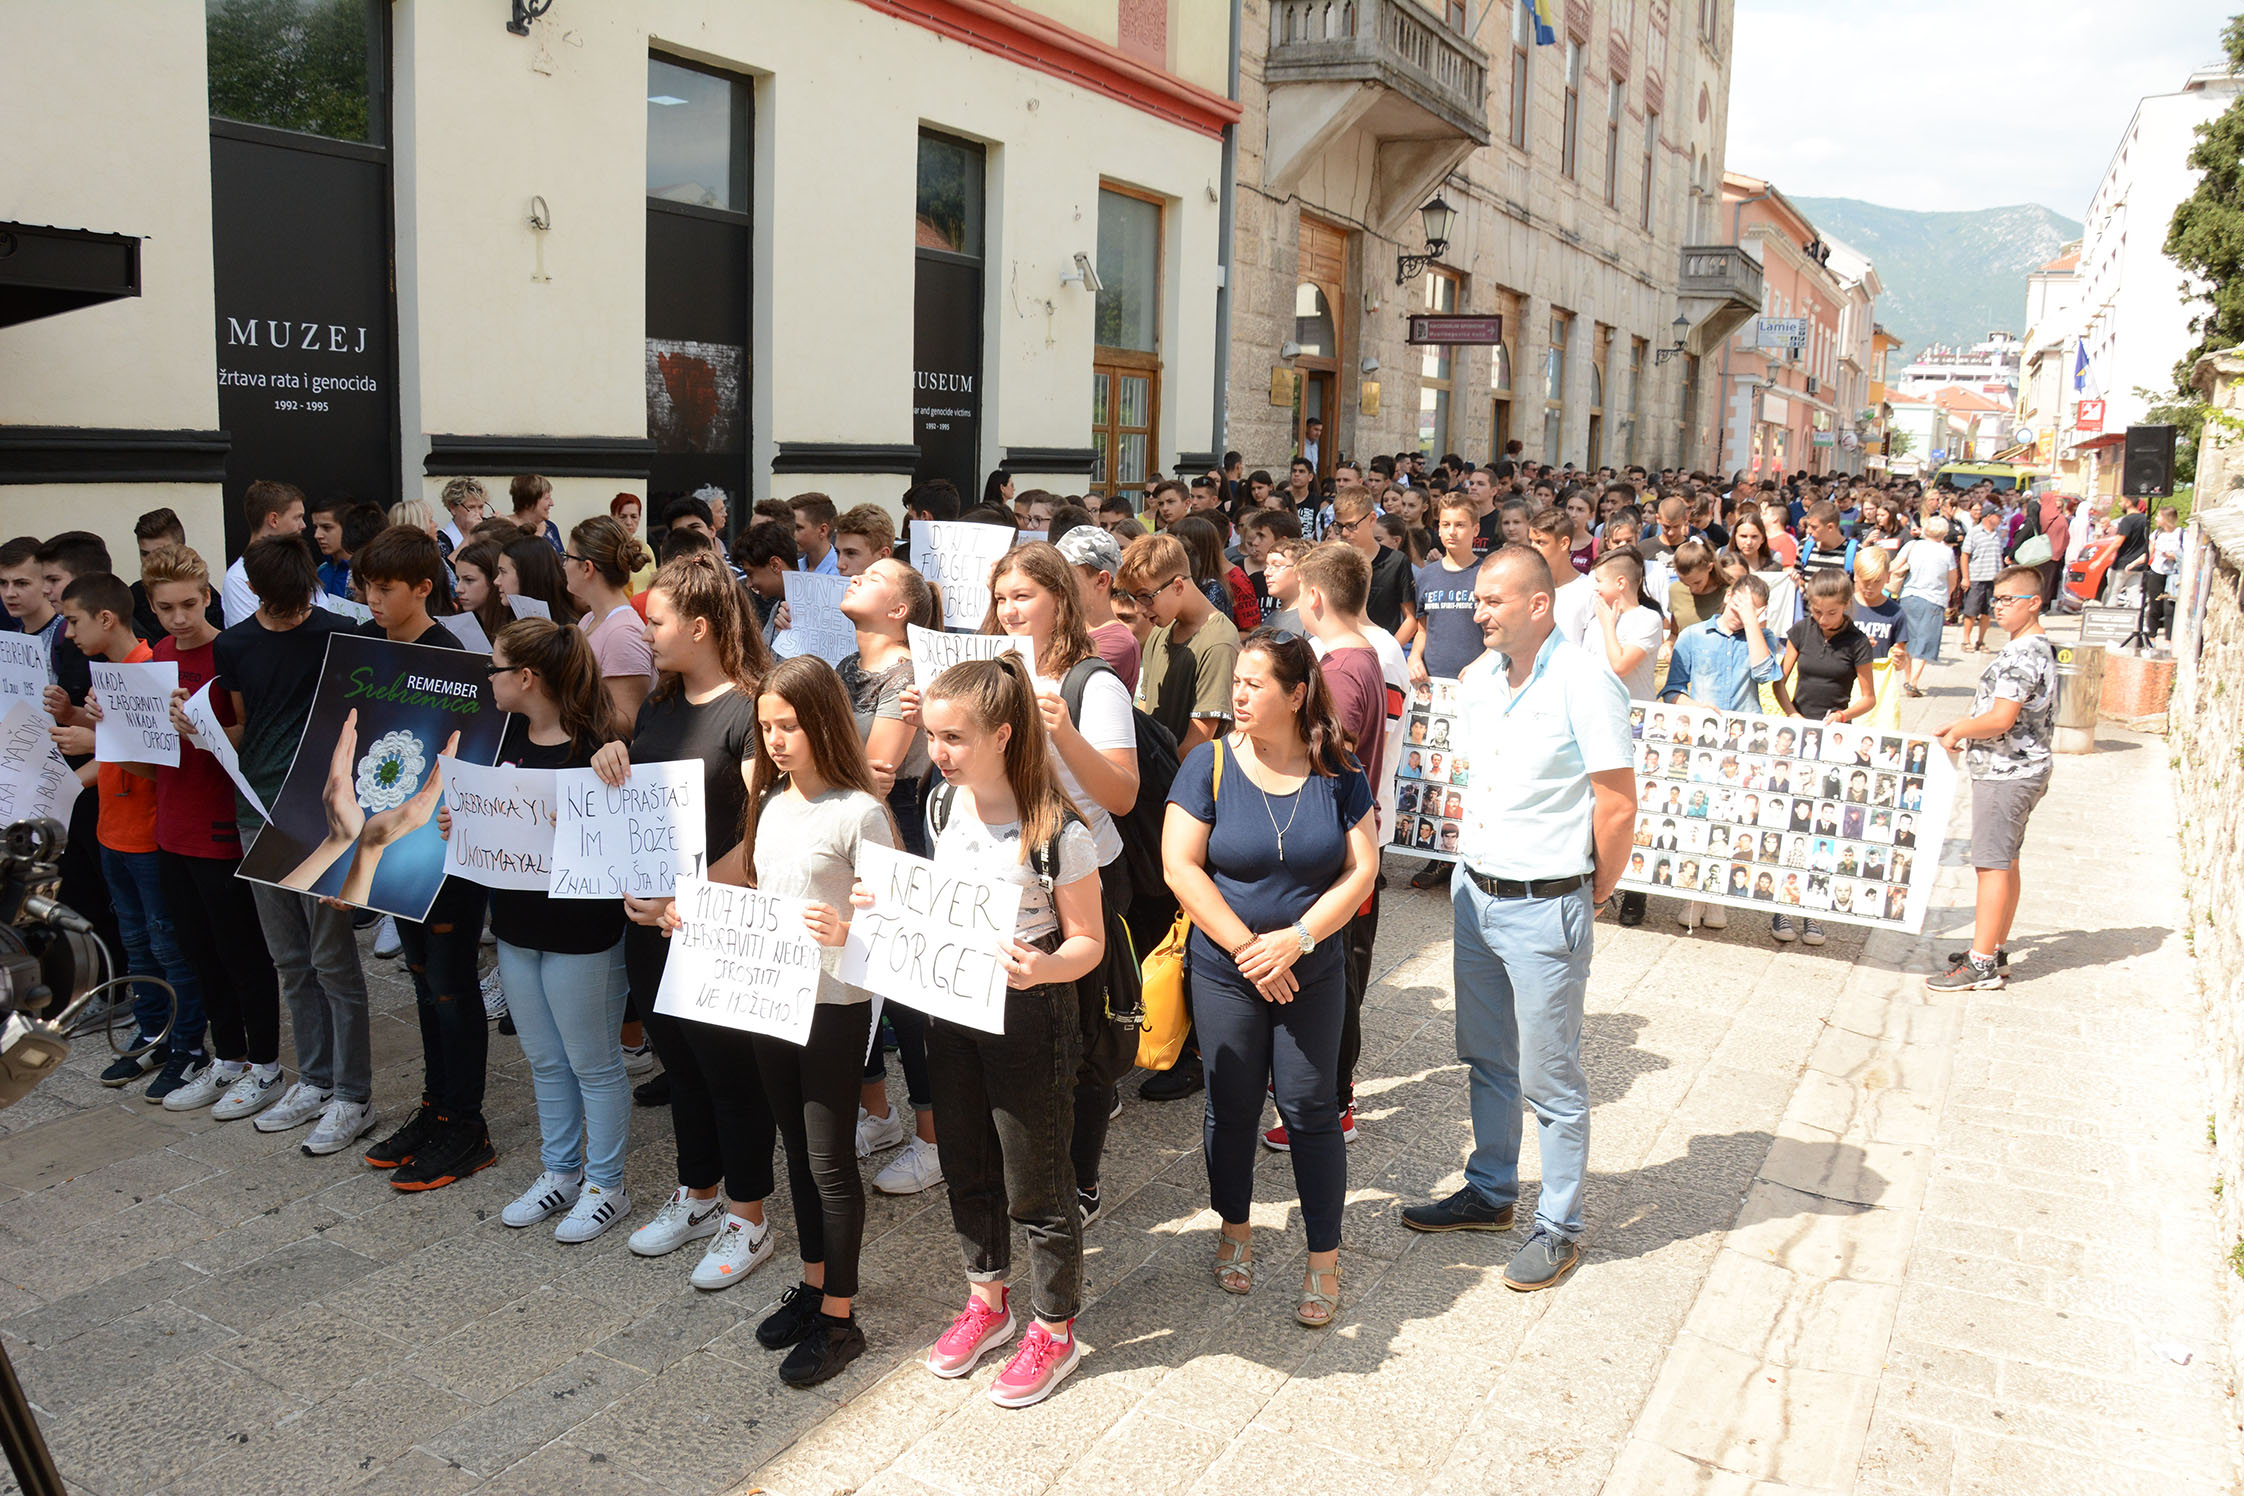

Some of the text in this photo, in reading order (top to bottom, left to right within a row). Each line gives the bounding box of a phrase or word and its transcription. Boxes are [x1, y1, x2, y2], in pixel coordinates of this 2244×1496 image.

[227, 317, 367, 353] MUZEJ
[1760, 321, 1796, 331] Lamie
[219, 368, 377, 393] žrtava rata i genocida
[912, 371, 973, 392] USEUM
[275, 400, 298, 410] 1992
[306, 401, 328, 411] 1995
[920, 406, 930, 415] and
[930, 407, 953, 418] genocide
[954, 408, 971, 417] victims
[921, 553, 986, 582] FORGET
[792, 574, 851, 605] DON'T
[942, 585, 986, 618] BRENI
[1448, 590, 1476, 602] OCEA
[919, 631, 1003, 668] SREBRENIC
[344, 666, 480, 713] Srebrenica
[407, 675, 478, 698] REMEMBER
[108, 695, 165, 712] ZABORAVITI
[125, 712, 158, 729] NIKADA
[143, 730, 179, 751] OPROSTIT
[568, 782, 689, 821] NE OPRAŠTAJ
[581, 816, 679, 857] IM BOŽE
[456, 828, 552, 875] UNUTMAYAL
[555, 869, 600, 894] ZNALI
[608, 866, 628, 894] SU
[633, 860, 652, 891] ŠTA
[891, 862, 999, 930] NEVER
[682, 922, 764, 959] ZABORAVITI
[715, 959, 780, 987] OPROSTITI
[865, 914, 997, 1007] FORGET
[696, 983, 720, 1008] NE
